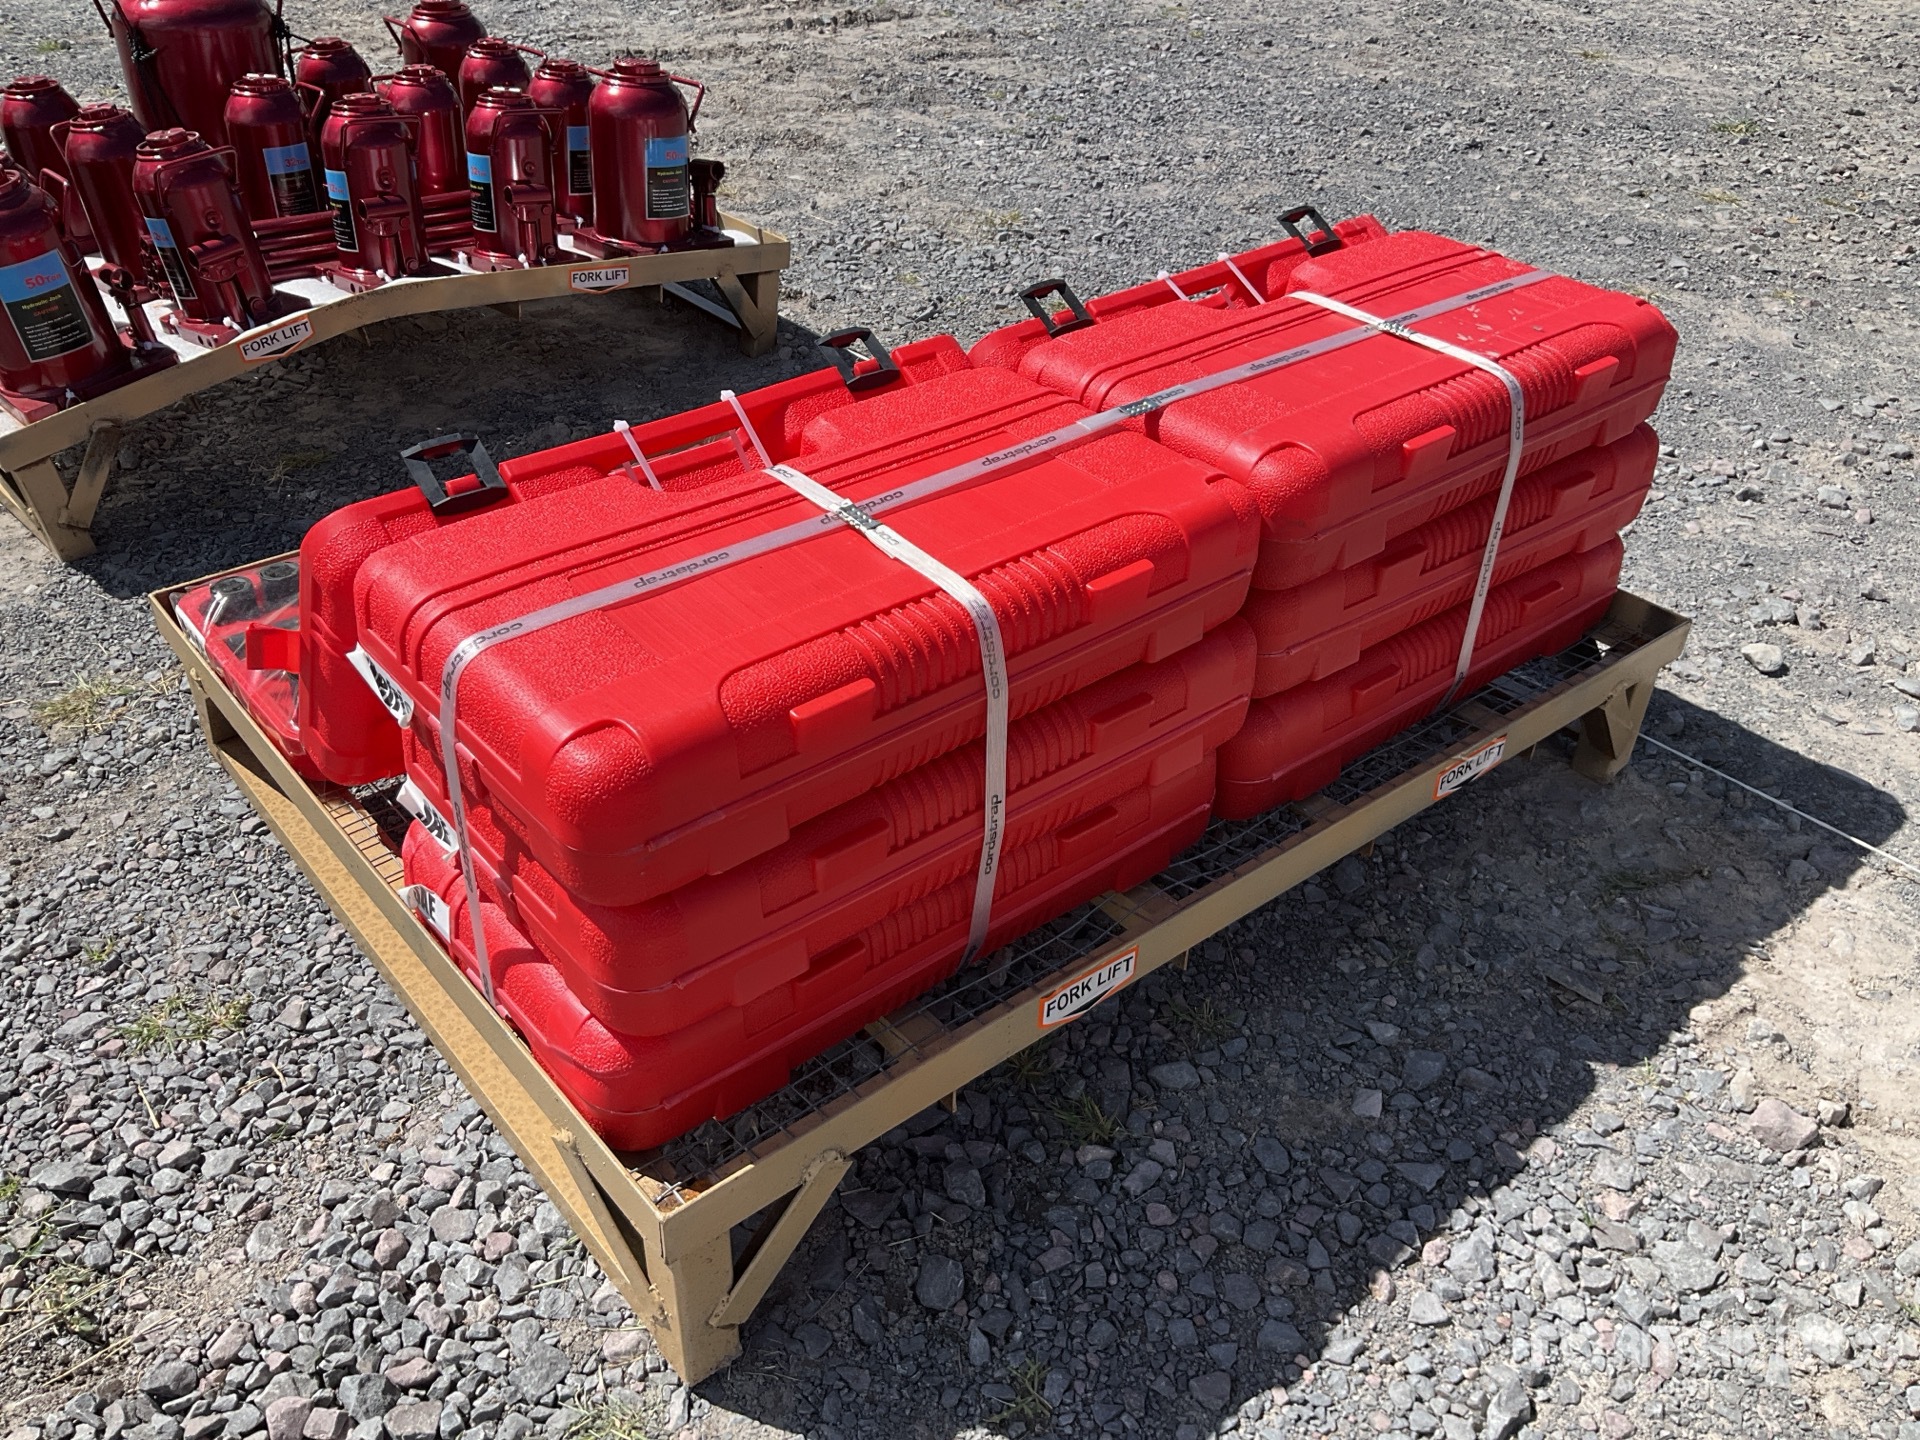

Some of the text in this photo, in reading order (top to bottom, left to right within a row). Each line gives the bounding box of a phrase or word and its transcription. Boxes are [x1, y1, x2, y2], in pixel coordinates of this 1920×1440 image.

[572, 269, 628, 284] FORK LIFT
[22, 299, 49, 310] Hydraulic
[242, 320, 310, 356] FORK LIFT
[981, 434, 1057, 467] cordstrap
[633, 551, 730, 589] cordstrap
[442, 621, 524, 701] cordstrap
[1440, 741, 1505, 790] FORK LIFT
[984, 794, 1002, 876] cordstrap
[1045, 955, 1134, 1018] FORK LIFT
